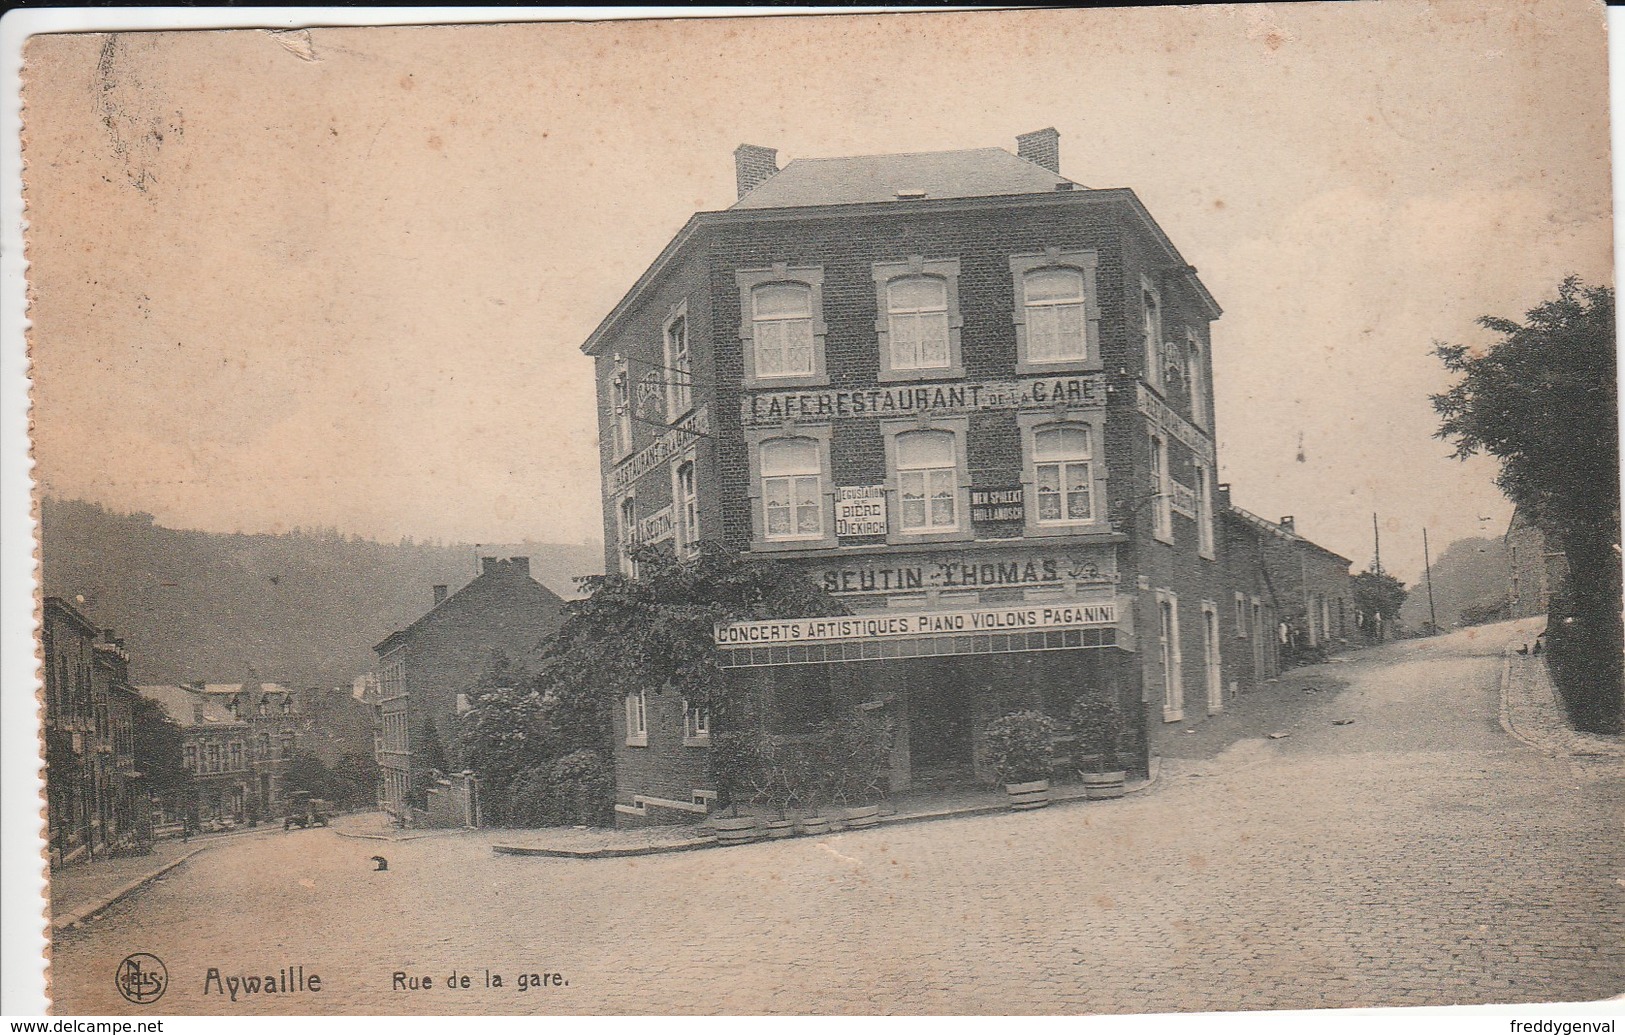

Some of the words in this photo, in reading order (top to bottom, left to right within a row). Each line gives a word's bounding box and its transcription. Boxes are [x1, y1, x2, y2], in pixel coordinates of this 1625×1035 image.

[817, 385, 983, 416] RESTAURANT
[1033, 379, 1096, 402] GARE
[837, 519, 885, 534] DIEKIRCH
[823, 568, 922, 593] SEUTIN
[718, 625, 800, 642] CONCERTS
[919, 615, 964, 631] PIANO
[972, 611, 1041, 627] VIOLONS
[1043, 606, 1115, 624] PAGANINI
